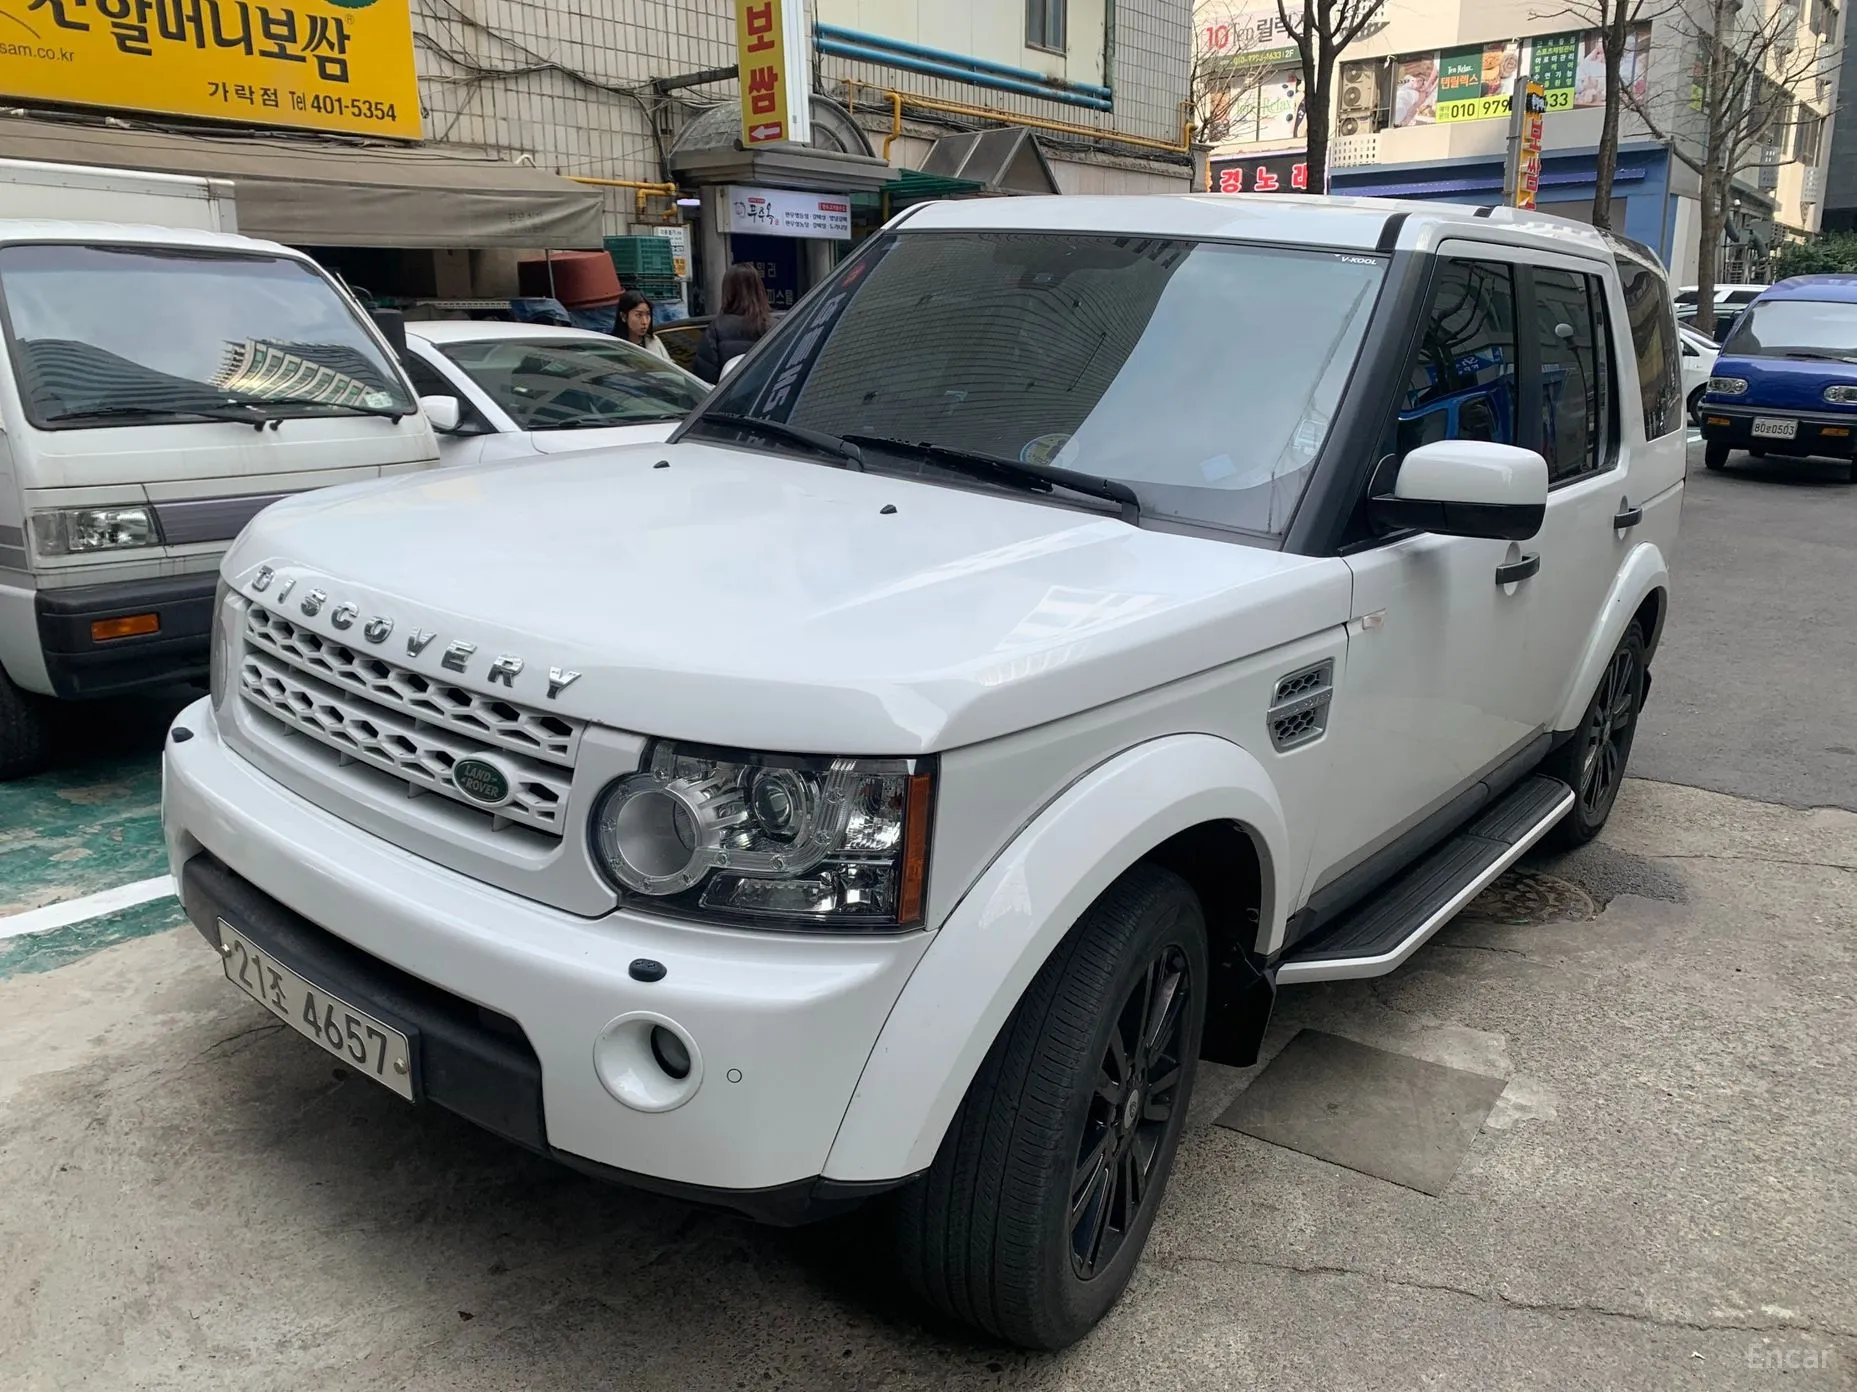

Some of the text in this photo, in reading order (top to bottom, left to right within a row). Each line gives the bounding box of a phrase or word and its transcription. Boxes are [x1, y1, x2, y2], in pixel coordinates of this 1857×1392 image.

[746, 1, 779, 115] 보쌈
[207, 82, 398, 122] 가락점 Tel 401-5354
[1451, 103, 1475, 118] 010
[1482, 99, 1509, 115] 979
[1341, 256, 1377, 265] V-KOOL
[252, 564, 583, 701] DISCOVERY
[464, 764, 492, 782] LAND
[465, 777, 499, 798] ROVER
[234, 939, 388, 1076] 21조 4657
